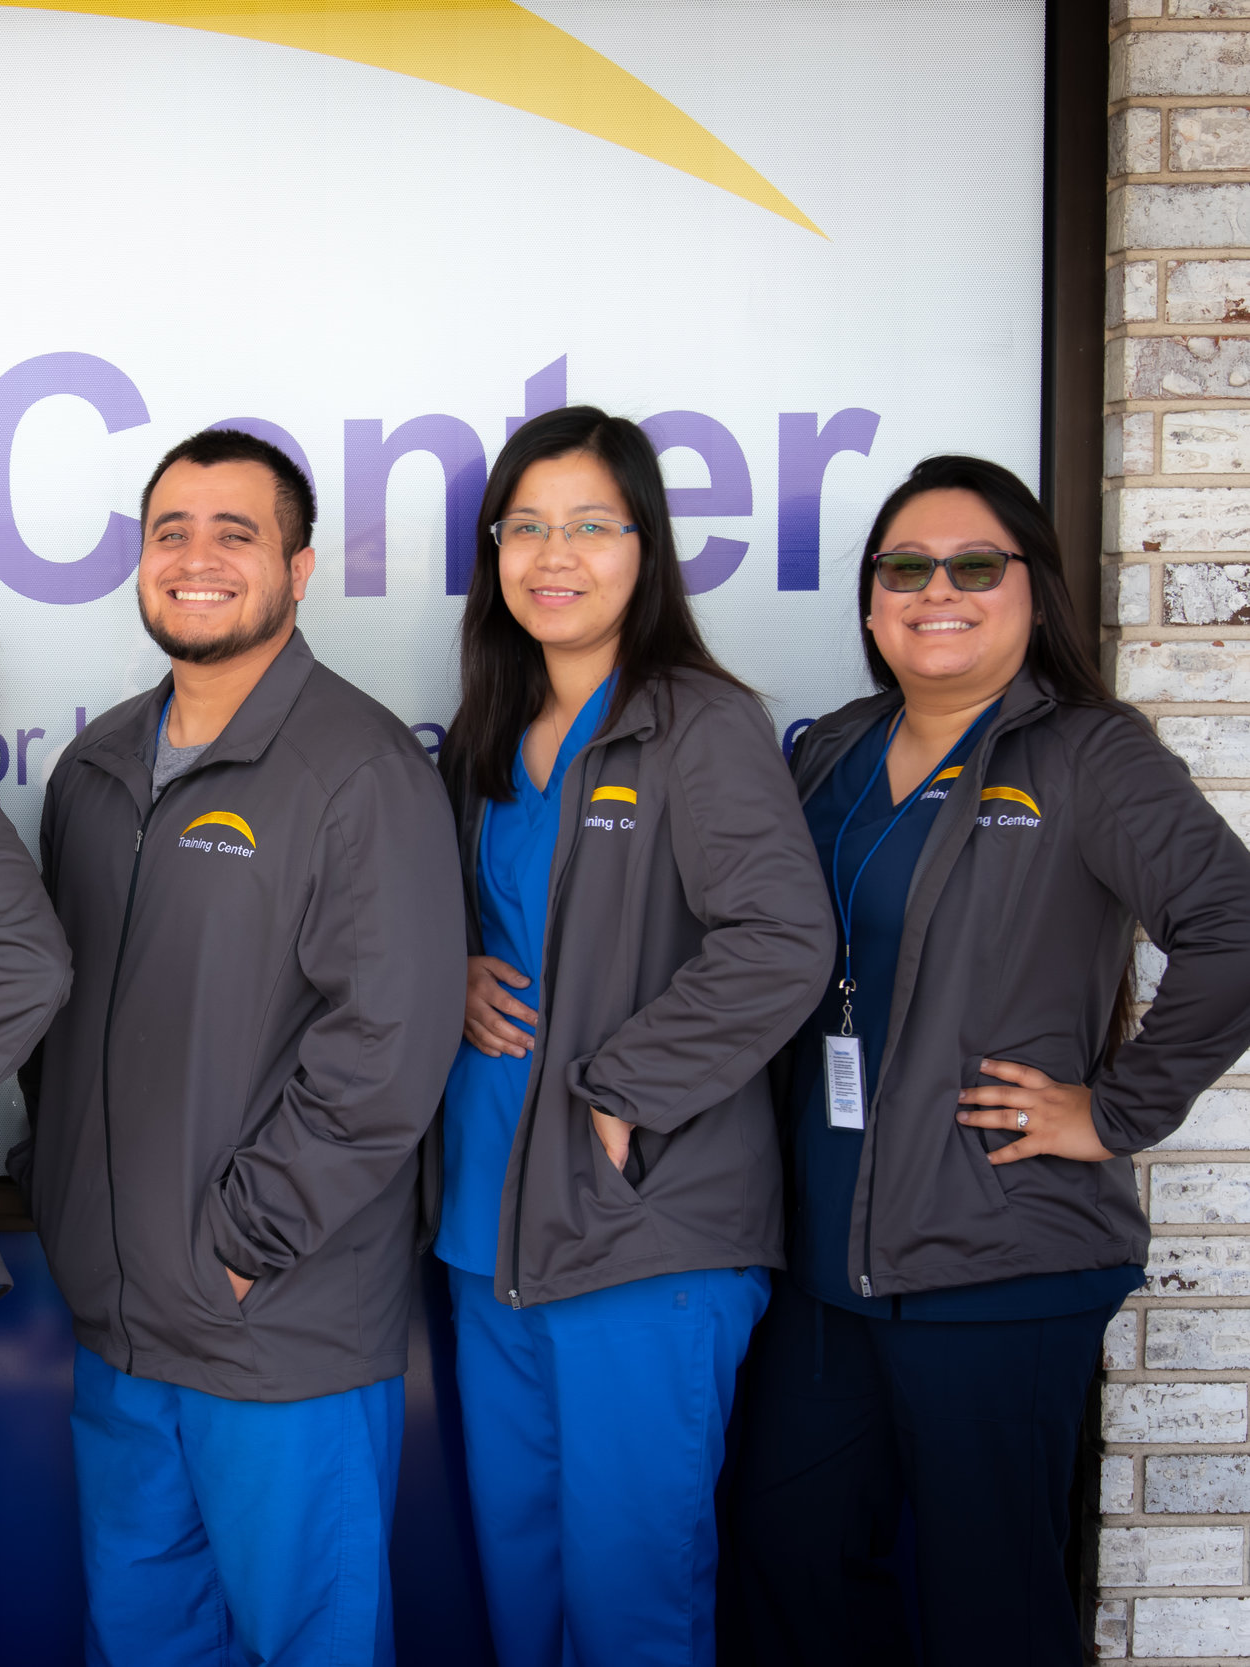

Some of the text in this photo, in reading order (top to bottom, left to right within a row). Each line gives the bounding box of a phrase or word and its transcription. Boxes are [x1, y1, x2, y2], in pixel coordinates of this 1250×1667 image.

[997, 814, 1041, 828] Center
[178, 836, 255, 858] Training Center
